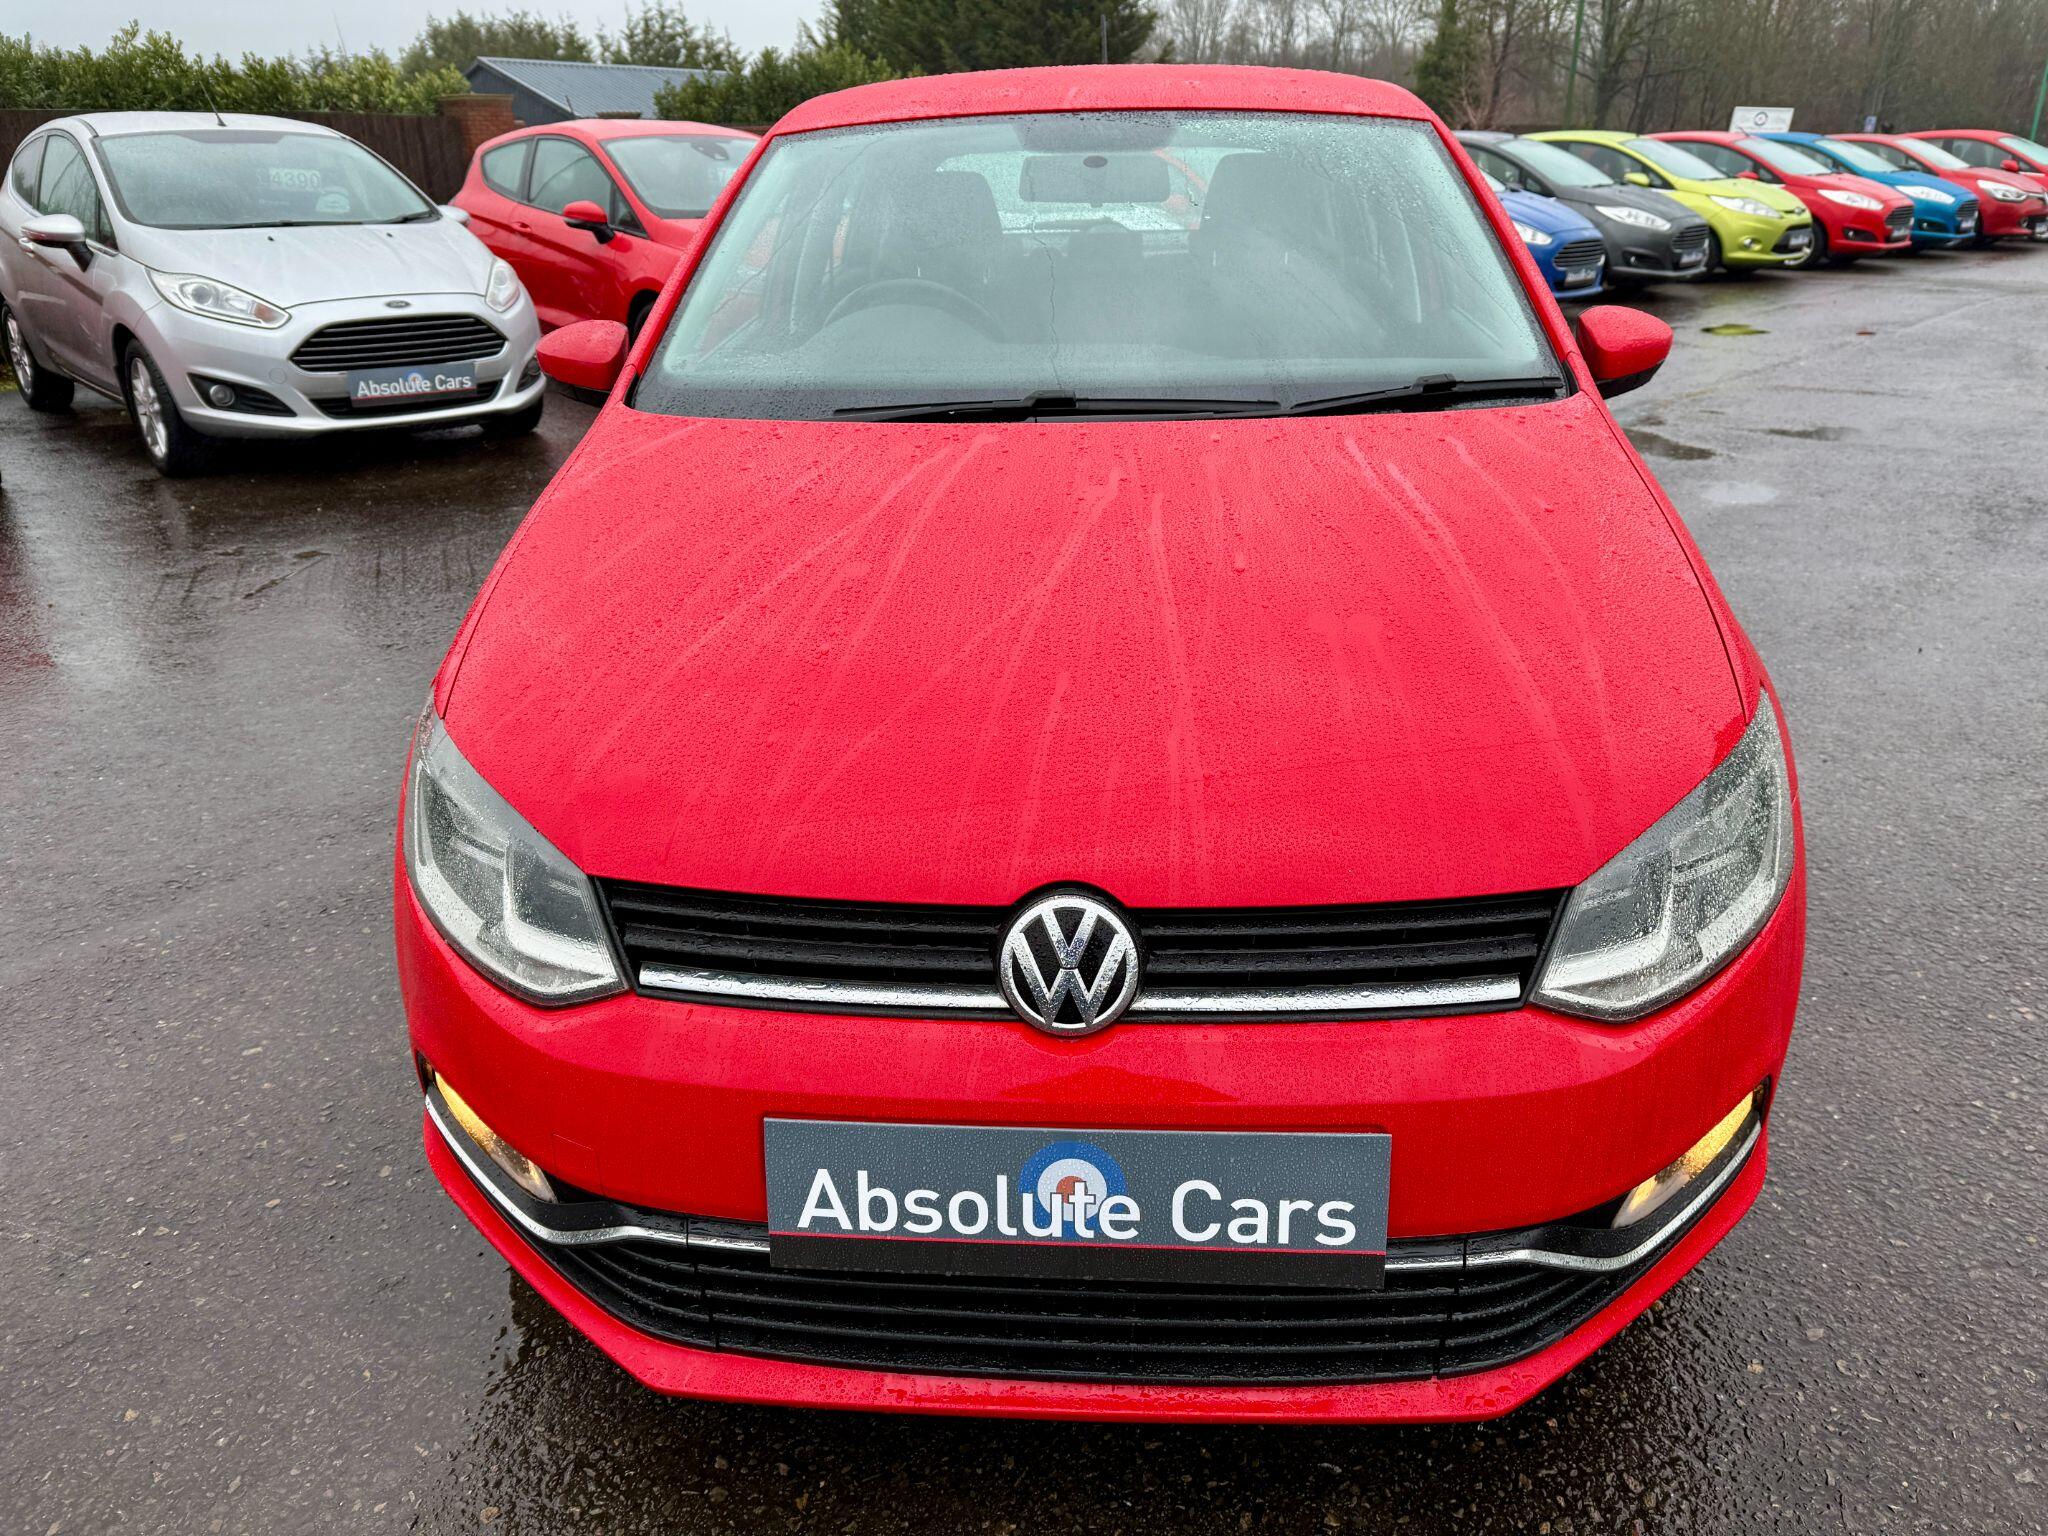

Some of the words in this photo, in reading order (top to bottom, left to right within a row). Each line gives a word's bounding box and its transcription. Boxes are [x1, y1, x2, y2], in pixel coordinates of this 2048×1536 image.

[357, 377, 431, 397] Absolute
[434, 374, 472, 390] Cars
[797, 1168, 1141, 1240] Absolute
[1171, 1179, 1357, 1246] Cars
